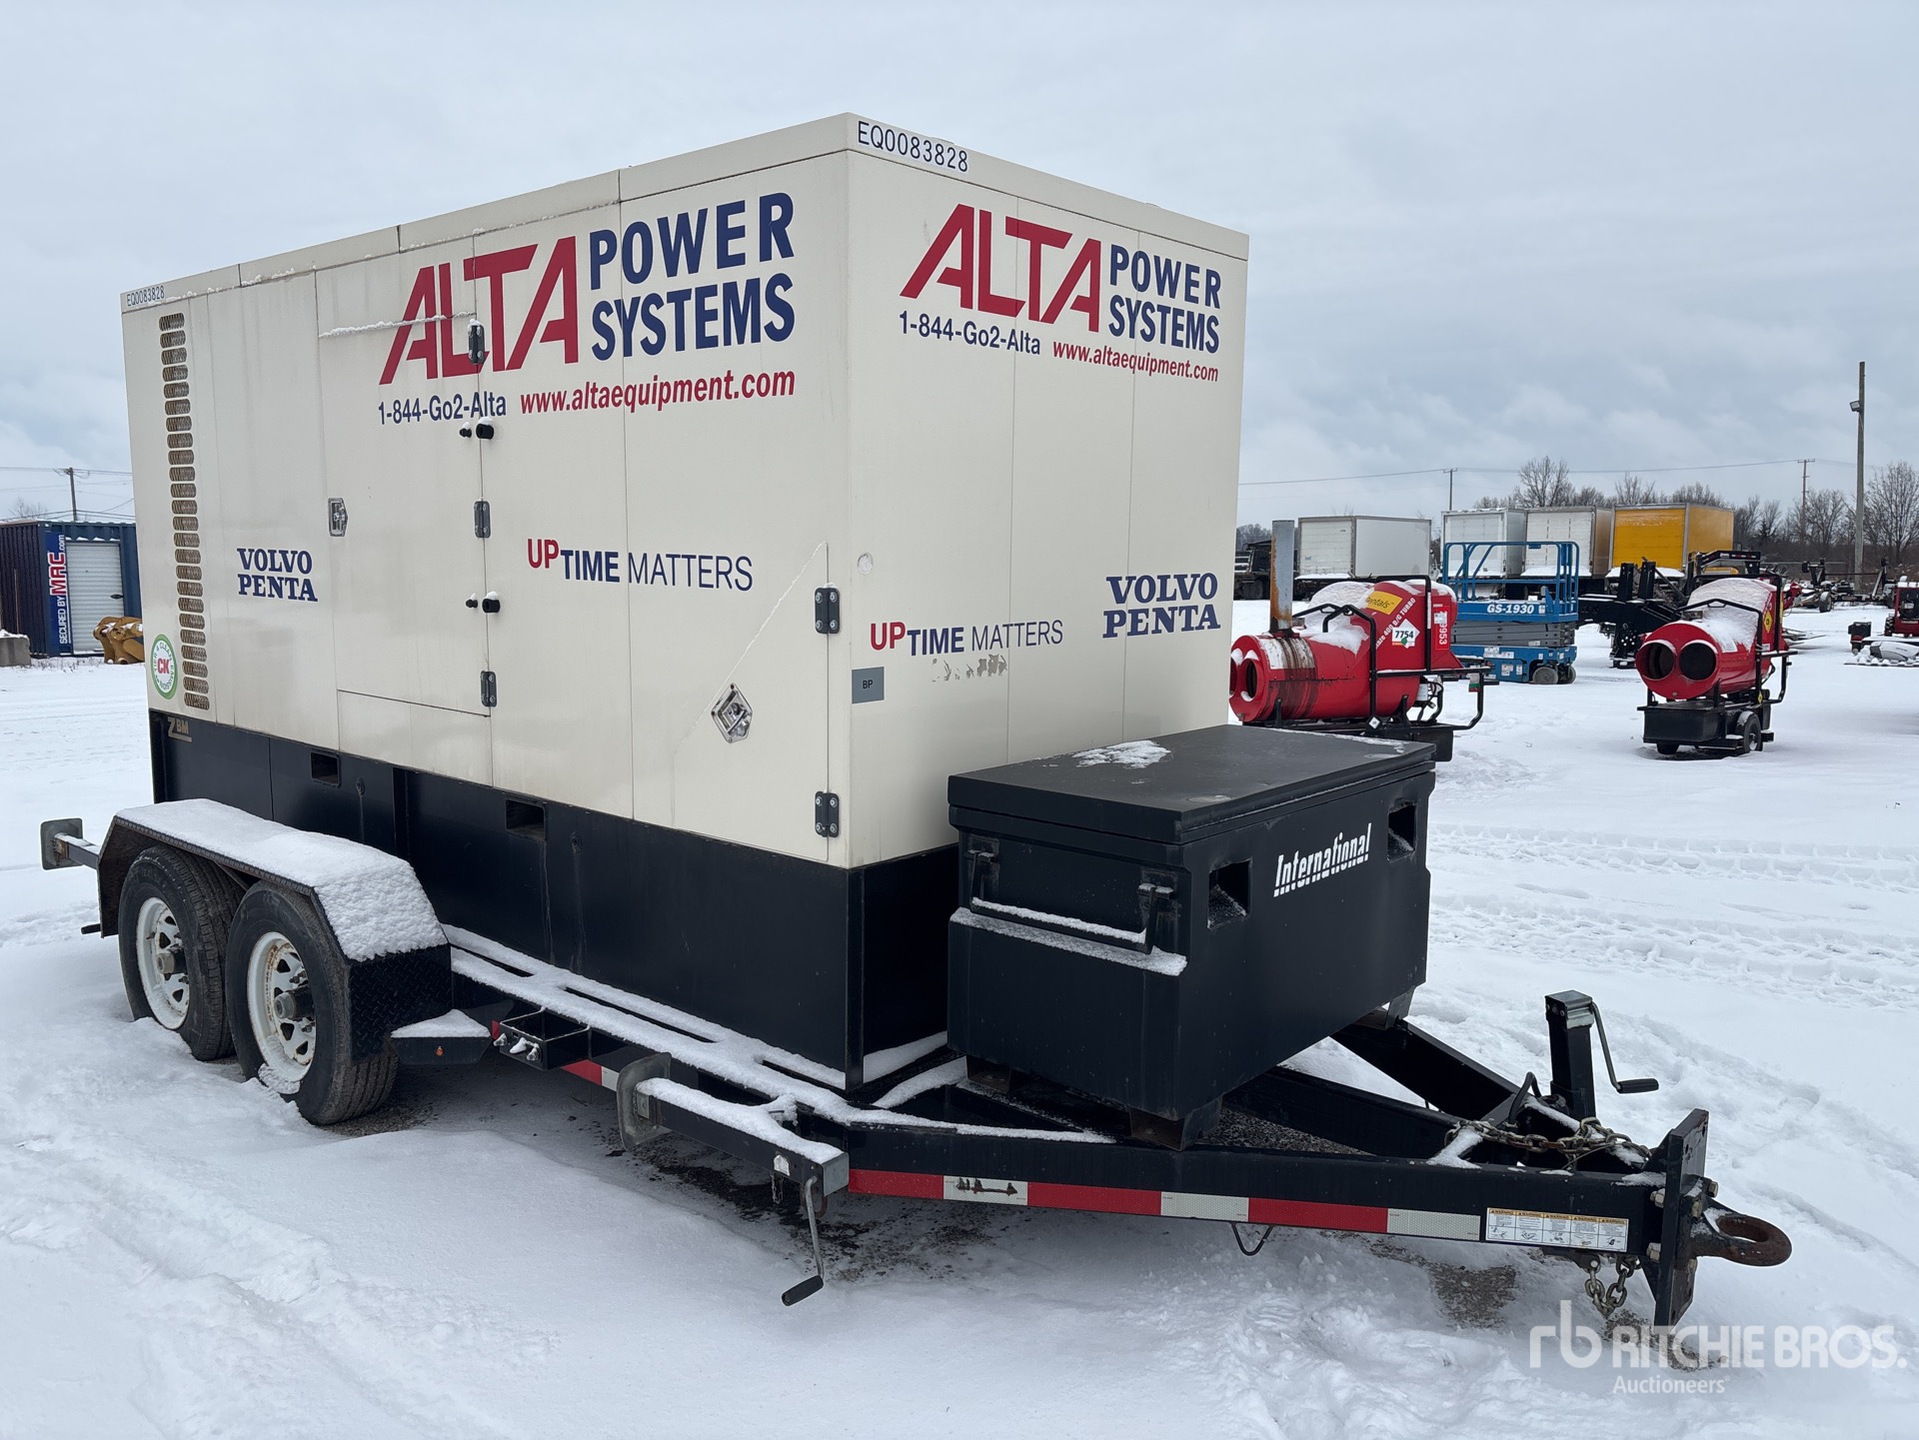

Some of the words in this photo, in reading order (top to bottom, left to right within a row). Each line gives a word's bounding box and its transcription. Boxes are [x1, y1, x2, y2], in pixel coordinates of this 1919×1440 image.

[857, 121, 969, 173] EQ0083828
[589, 192, 795, 290] POWER
[899, 203, 1101, 333] ALTA
[1109, 243, 1222, 309] POWER
[127, 285, 165, 307] EQ0083828
[379, 236, 579, 385] ALTA
[591, 272, 795, 361] SYSTEMS
[899, 310, 1041, 355] 1-844-Go2-Alta
[1108, 294, 1220, 354] SYSTEMS
[1052, 341, 1219, 382] www.altaequipment.com
[378, 391, 507, 425] 1-844-Go2-Alta
[520, 370, 795, 414] www.altaequipment.com
[236, 548, 313, 575] VOLVO
[628, 552, 753, 592] MATTERS
[56, 596, 66, 607] BY
[237, 573, 319, 602] PENTA
[1106, 572, 1218, 604] VOLVO
[1102, 604, 1221, 638] PENTA
[1400, 597, 1416, 616] TURBO
[1486, 604, 1535, 614] GS-1930
[57, 608, 68, 645] SECURED
[971, 620, 1063, 651] MATTERS
[1395, 630, 1414, 639] 7754
[157, 658, 170, 674] CK
[862, 679, 873, 689] BP
[1273, 822, 1372, 898] International
